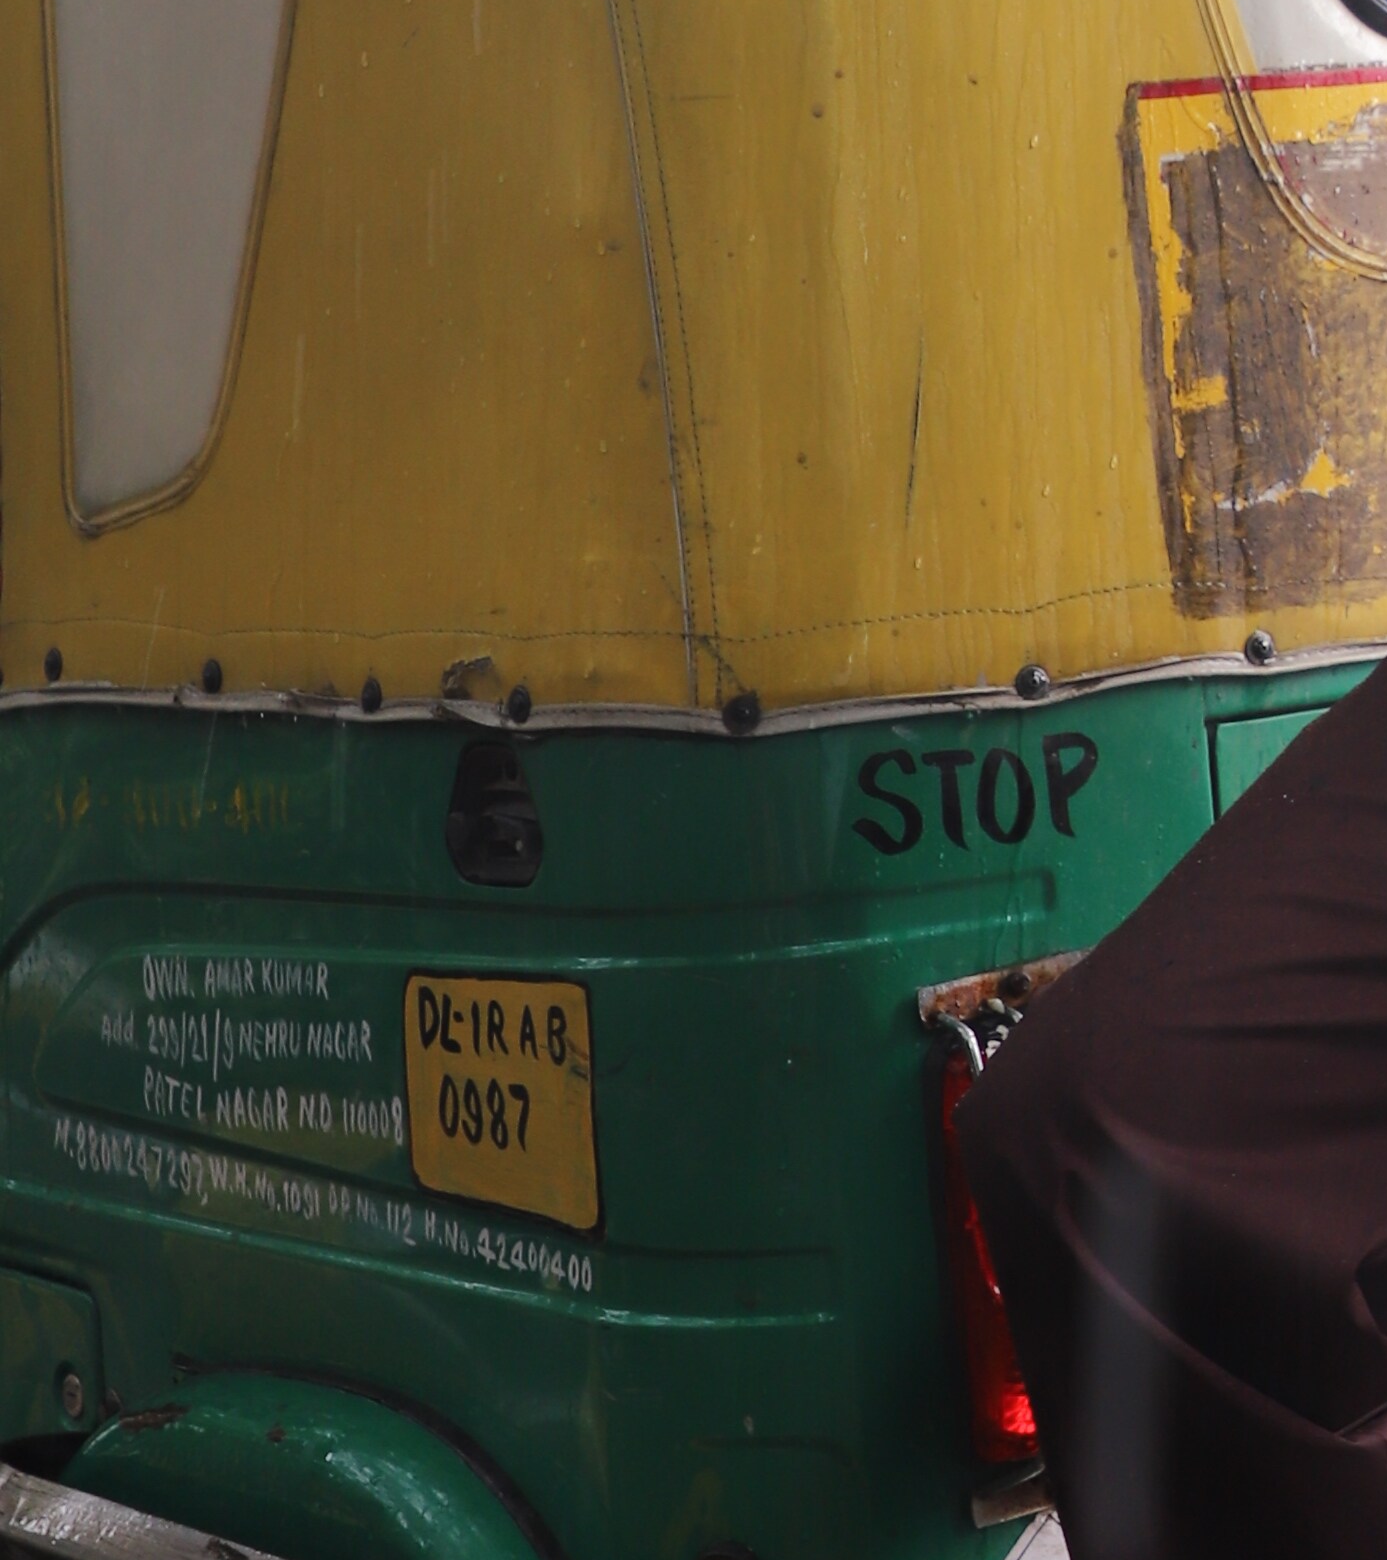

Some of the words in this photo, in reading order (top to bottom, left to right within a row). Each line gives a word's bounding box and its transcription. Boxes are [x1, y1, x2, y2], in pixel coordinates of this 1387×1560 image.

[852, 731, 1099, 856] STOP
[205, 958, 256, 998] AMAR
[261, 958, 330, 1000] KUMAR
[239, 1019, 301, 1062] NEHRU
[307, 1019, 373, 1062] NAGAR
[143, 1065, 206, 1125] PATEL
[216, 1085, 290, 1132] NAGAR
[342, 1096, 404, 1147] 110008
[438, 1073, 531, 1153] 0987
